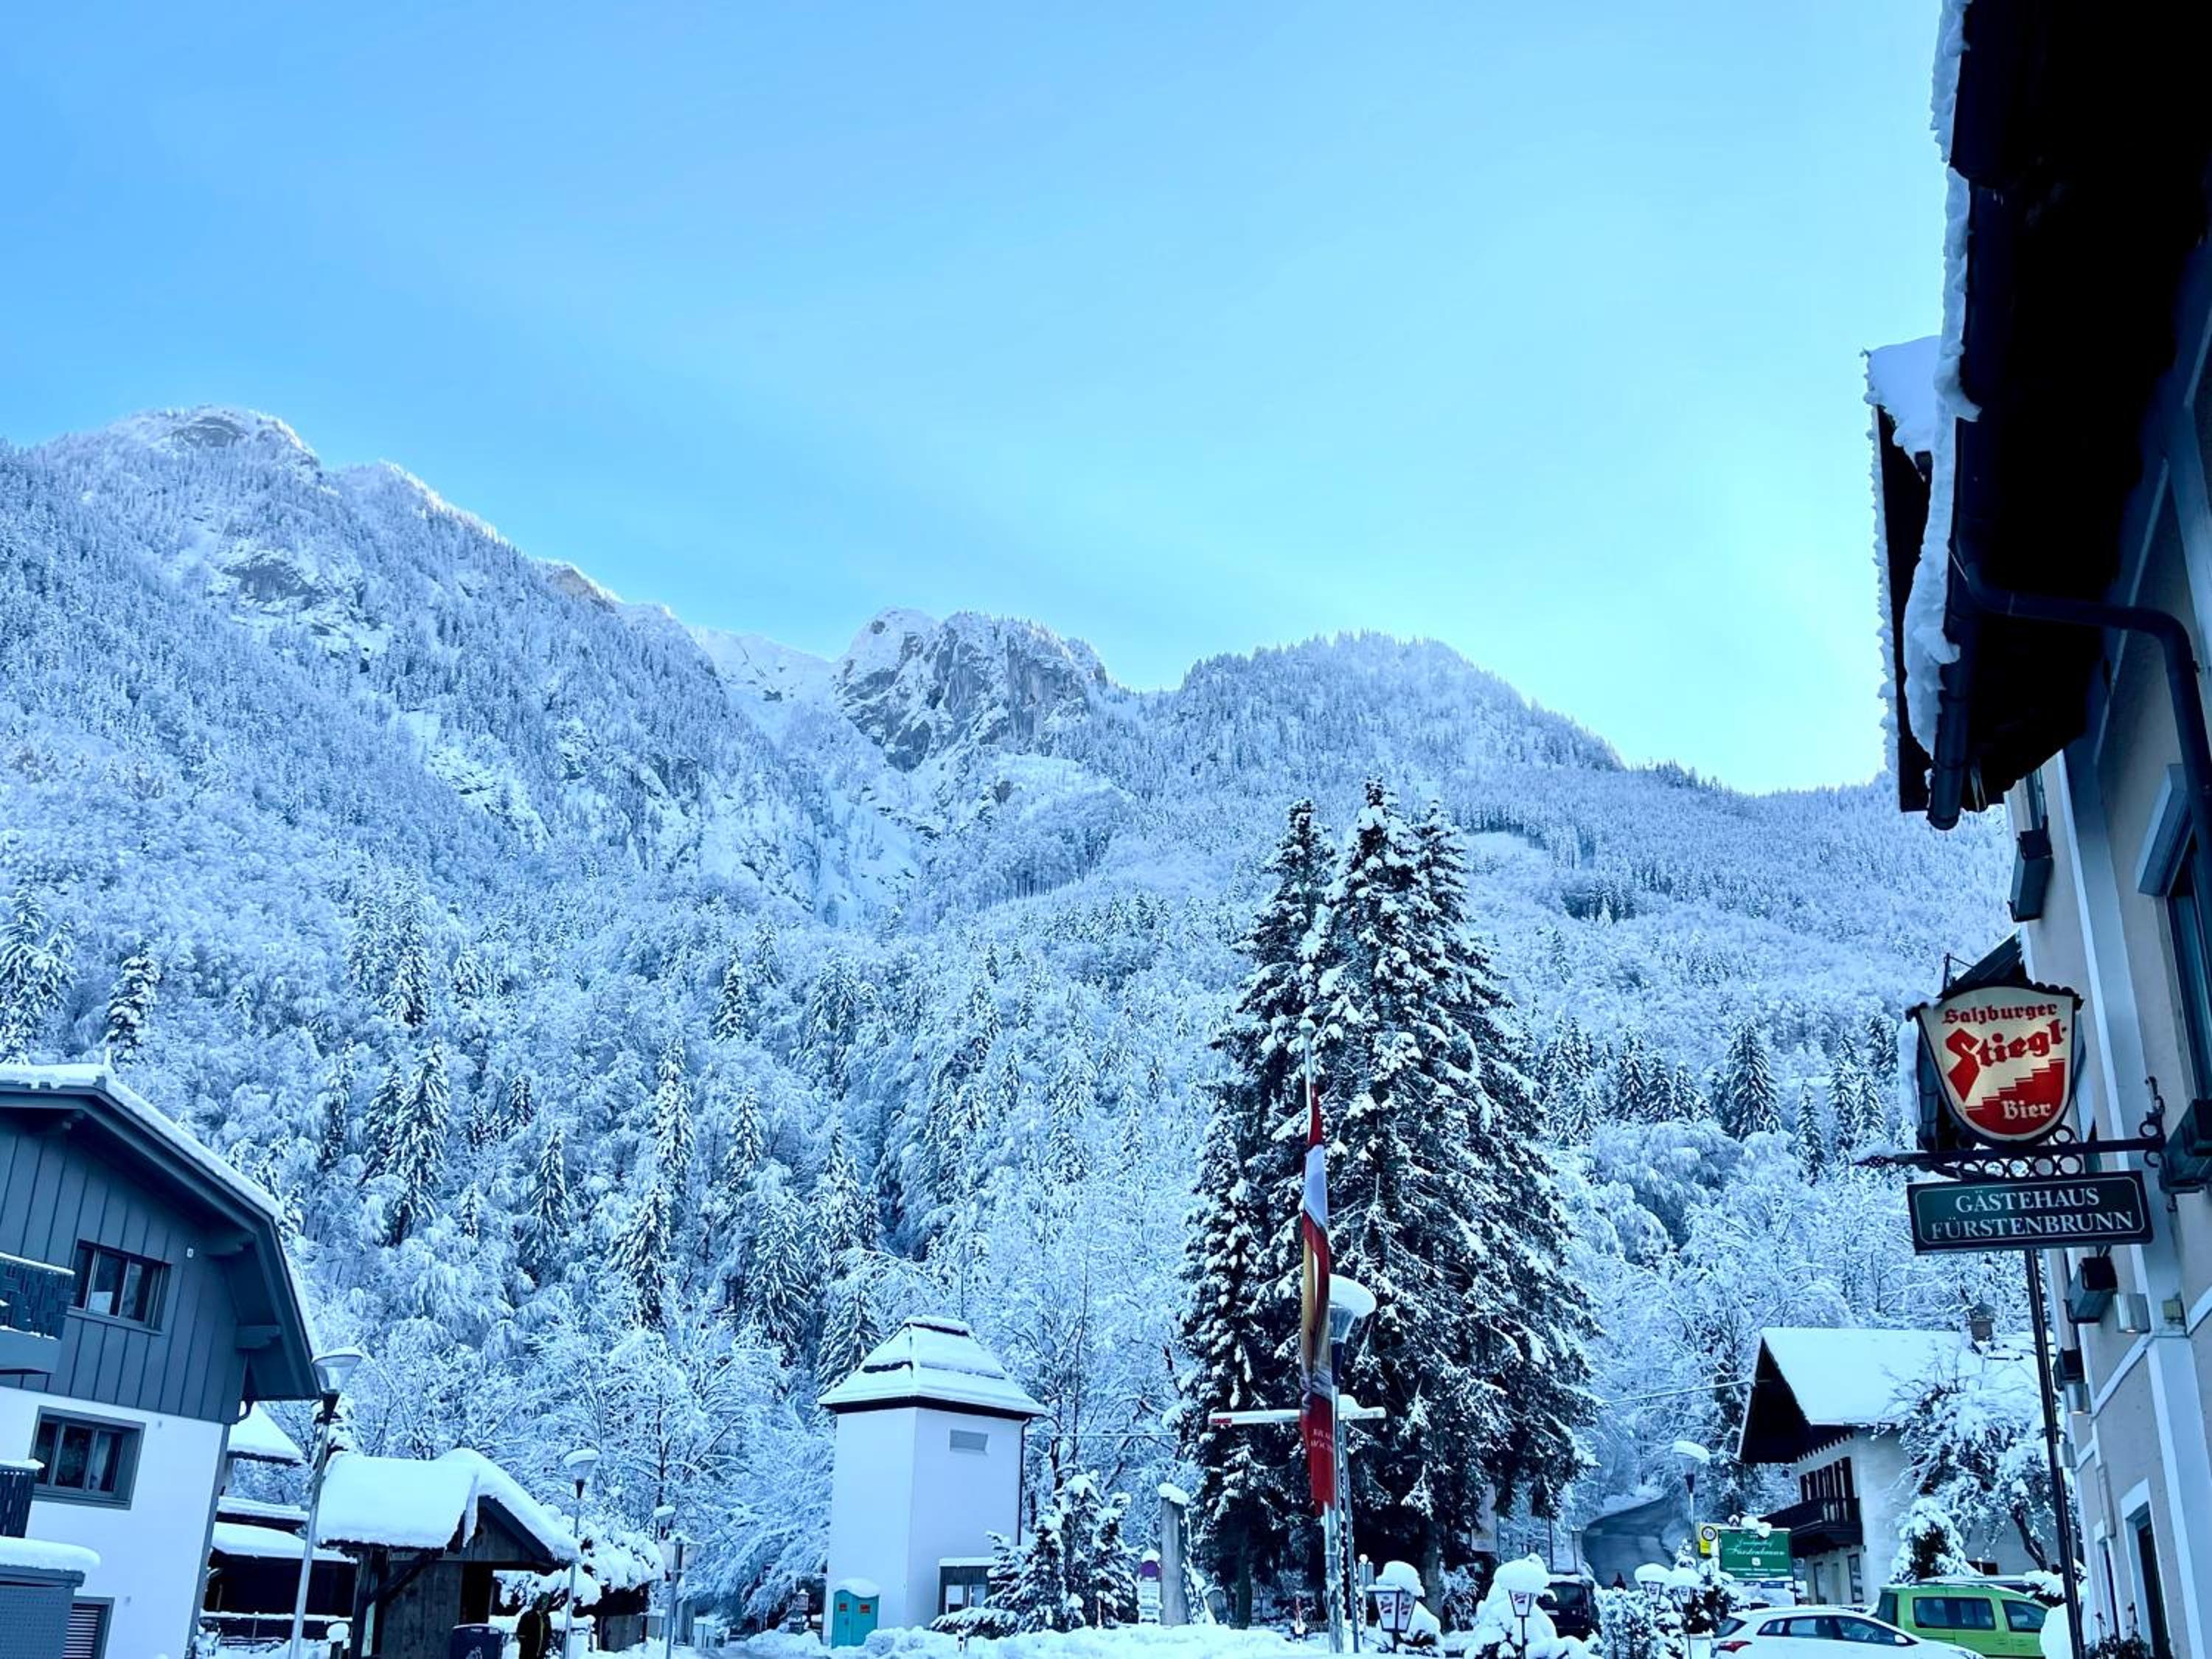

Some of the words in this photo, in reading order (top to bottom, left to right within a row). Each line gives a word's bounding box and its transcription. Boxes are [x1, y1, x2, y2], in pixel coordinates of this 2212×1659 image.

[1942, 1004, 2058, 1024] Salzburger
[2001, 1100, 2051, 1120] Bier
[1955, 1187, 2100, 1213] GÄSTEHAUS
[1931, 1211, 2134, 1239] FÜRSTENBRUNN
